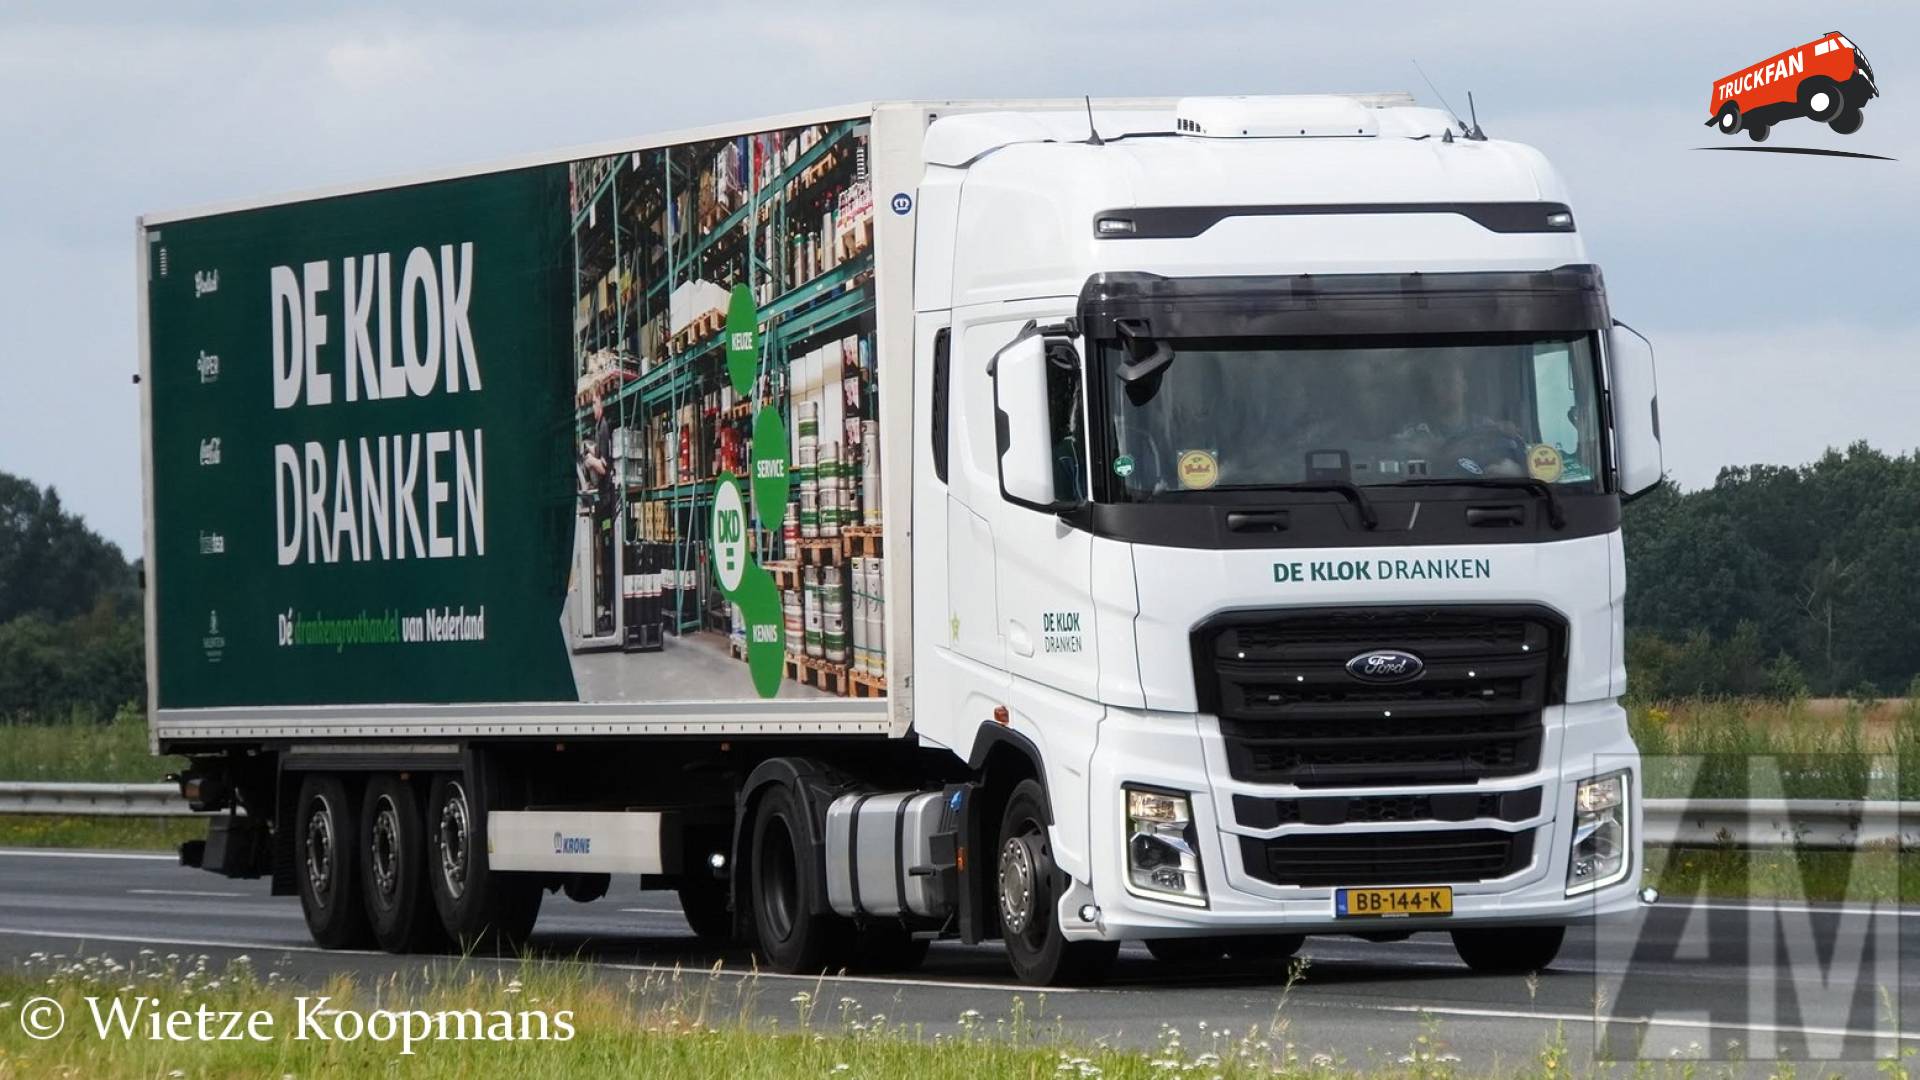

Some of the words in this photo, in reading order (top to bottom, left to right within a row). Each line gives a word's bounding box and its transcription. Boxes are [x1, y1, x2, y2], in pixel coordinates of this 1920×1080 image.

[270, 260, 332, 409] DE
[343, 241, 482, 402] KLOK
[731, 332, 753, 351] KEUZE
[757, 459, 785, 478] SERVICE
[275, 428, 485, 566] DRANKEN
[718, 509, 740, 544] DKD
[1273, 563, 1304, 582] DE
[1310, 560, 1372, 581] KLOK
[1378, 559, 1491, 580] DRANKEN
[278, 607, 293, 646] Dé
[402, 615, 424, 642] van
[425, 605, 485, 642] Nederland
[1043, 613, 1055, 632] DE
[1056, 612, 1081, 632] KLOK
[752, 625, 778, 643] KENNIS
[1044, 636, 1082, 653] DRANKEN
[1364, 655, 1407, 674] Ford
[563, 838, 591, 854] KRONE
[1356, 891, 1442, 910] BB-144-K
